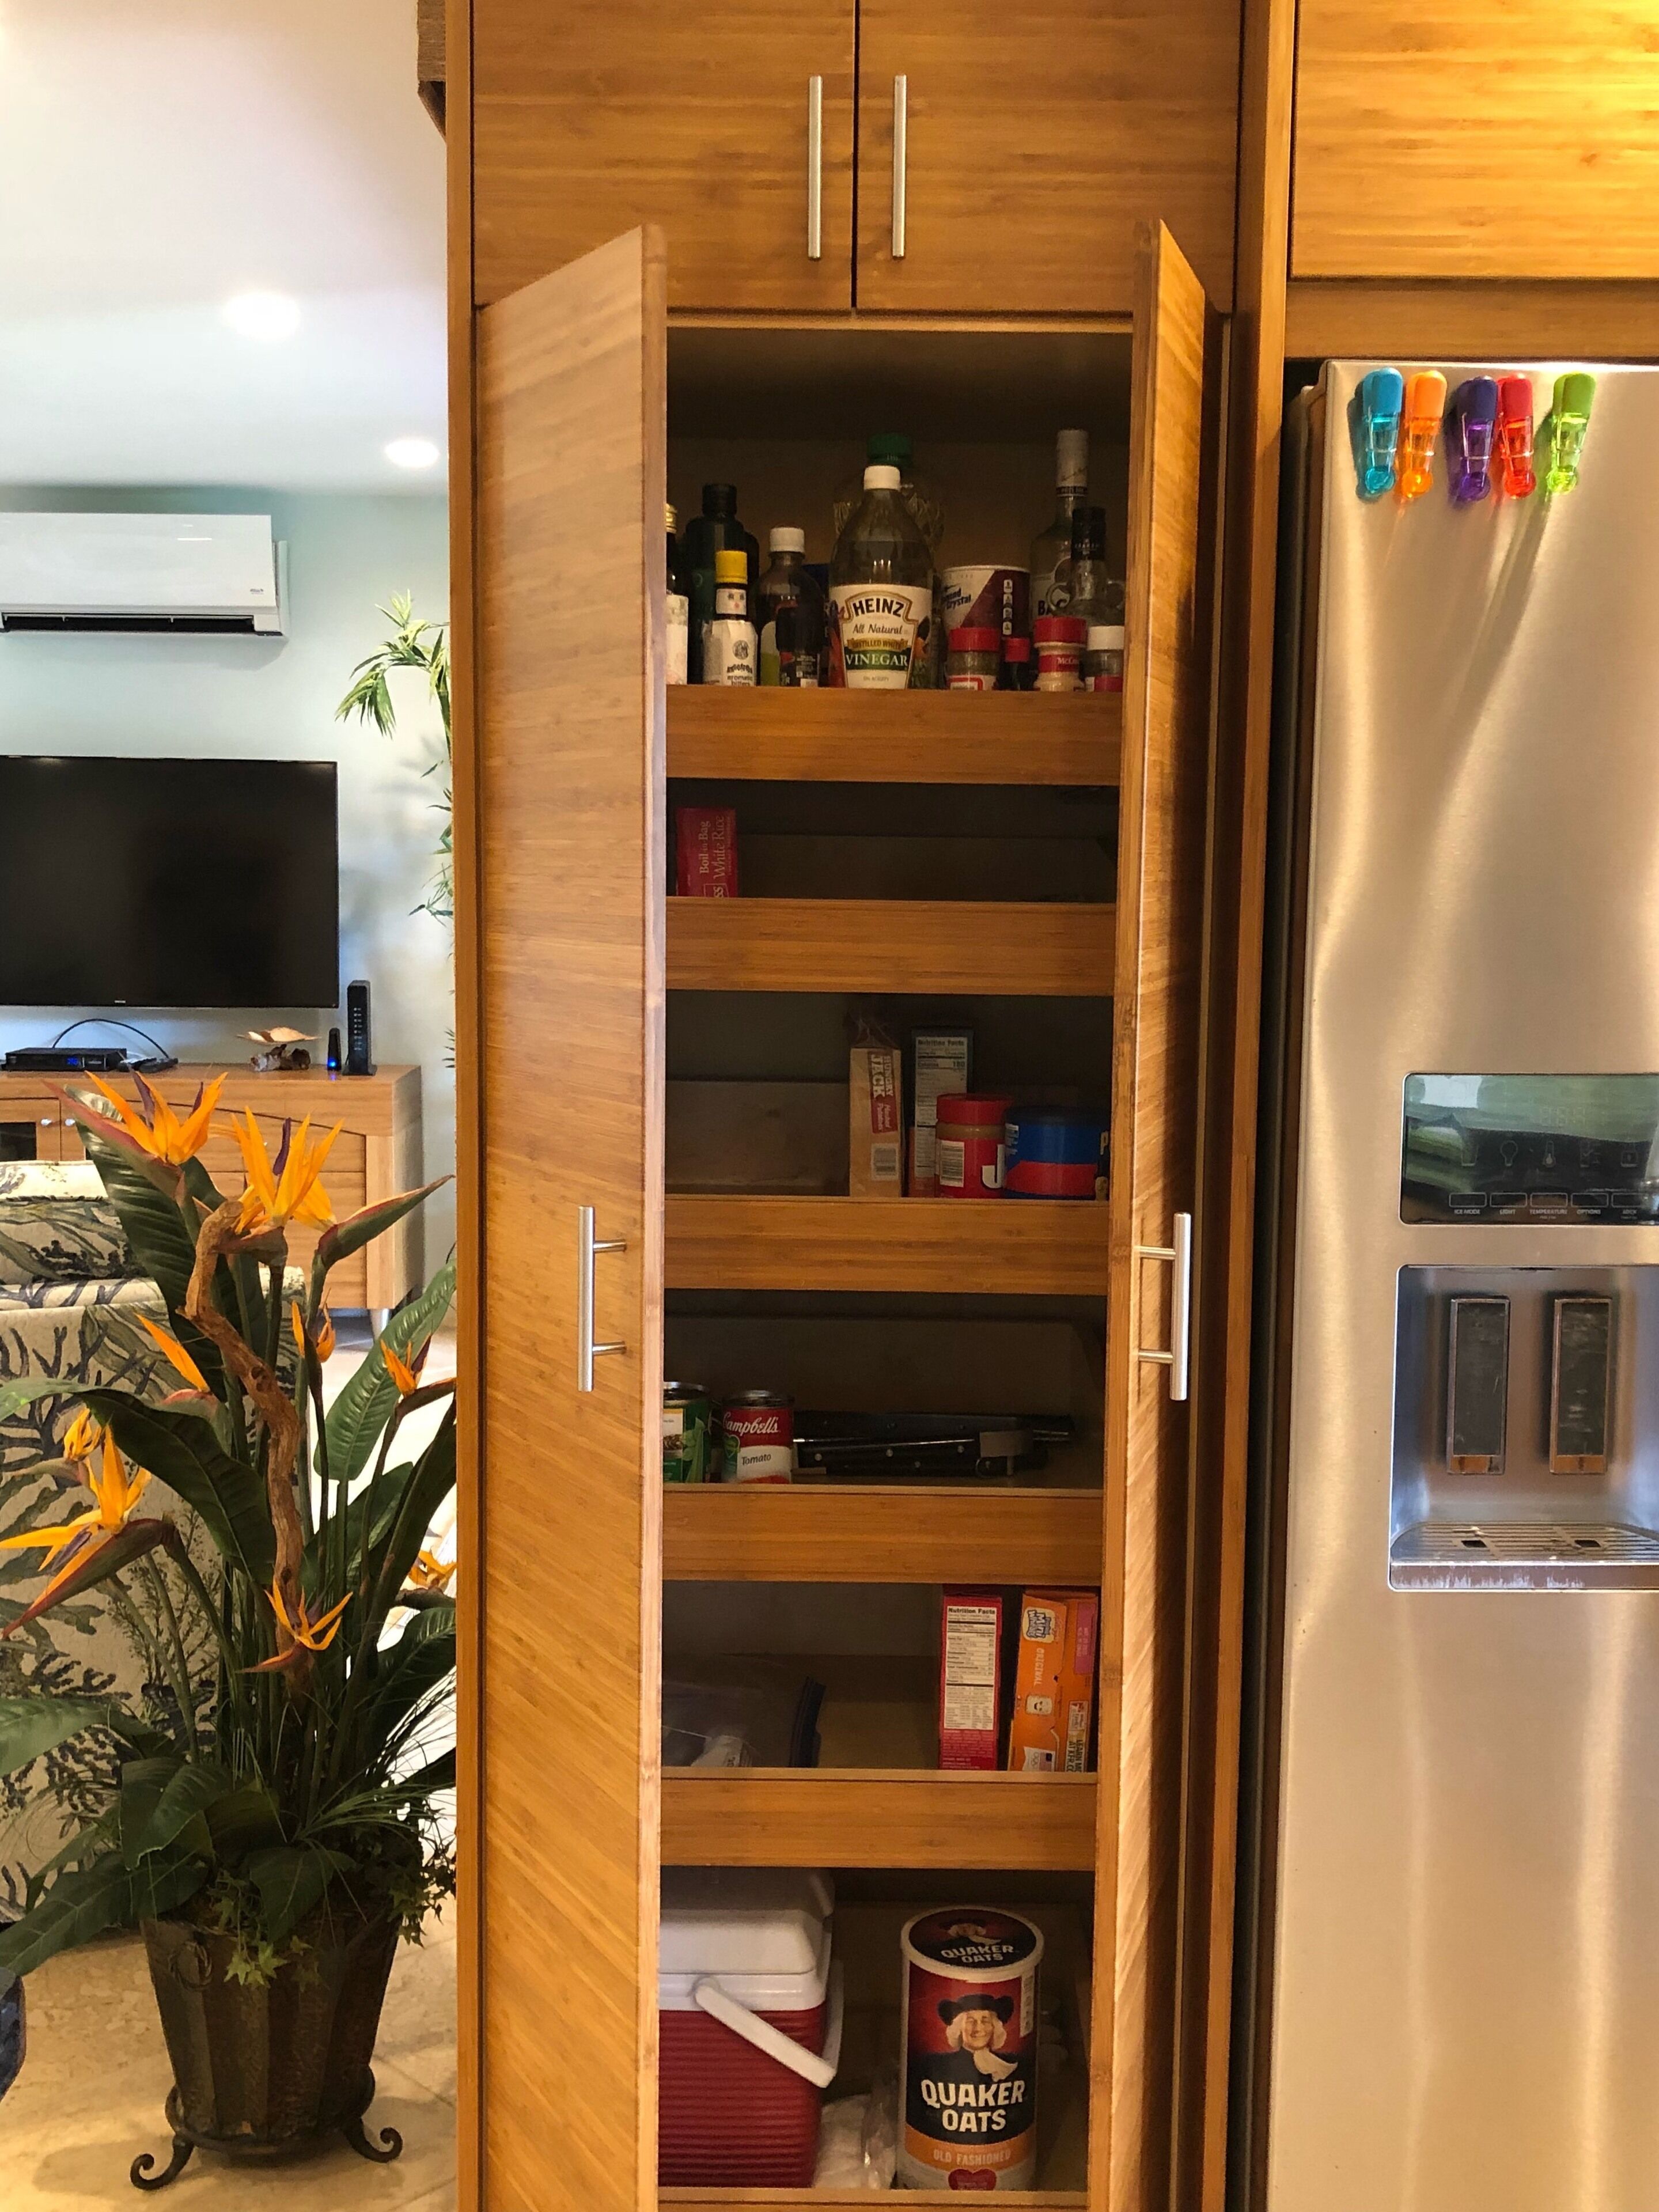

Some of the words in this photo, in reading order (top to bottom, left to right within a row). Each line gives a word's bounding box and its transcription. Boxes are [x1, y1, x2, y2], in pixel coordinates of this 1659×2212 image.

[853, 598, 904, 617] HEINZ
[853, 623, 865, 634] All
[868, 623, 903, 634] Natural
[846, 653, 908, 666] VINEGAR
[711, 815, 725, 841] Rice
[698, 821, 711, 874] Boil-in-Bag
[711, 843, 726, 880] White
[870, 1054, 885, 1099] JACK
[884, 1055, 893, 1096] HUNGRY
[722, 1412, 779, 1436] Campbell's
[741, 1454, 771, 1465] Tomato
[1034, 1647, 1044, 1687] ORIGINAL
[1067, 1749, 1075, 1772] KFR.CO
[1075, 1740, 1084, 1762] LEARN
[941, 1945, 1014, 1959] QUAKER
[961, 1953, 1003, 1963] OATS
[921, 2079, 1025, 2108] QUAKER
[942, 2109, 1006, 2133] OATS
[934, 2149, 952, 2163] OLD
[956, 2150, 1012, 2165] FASHIONED
